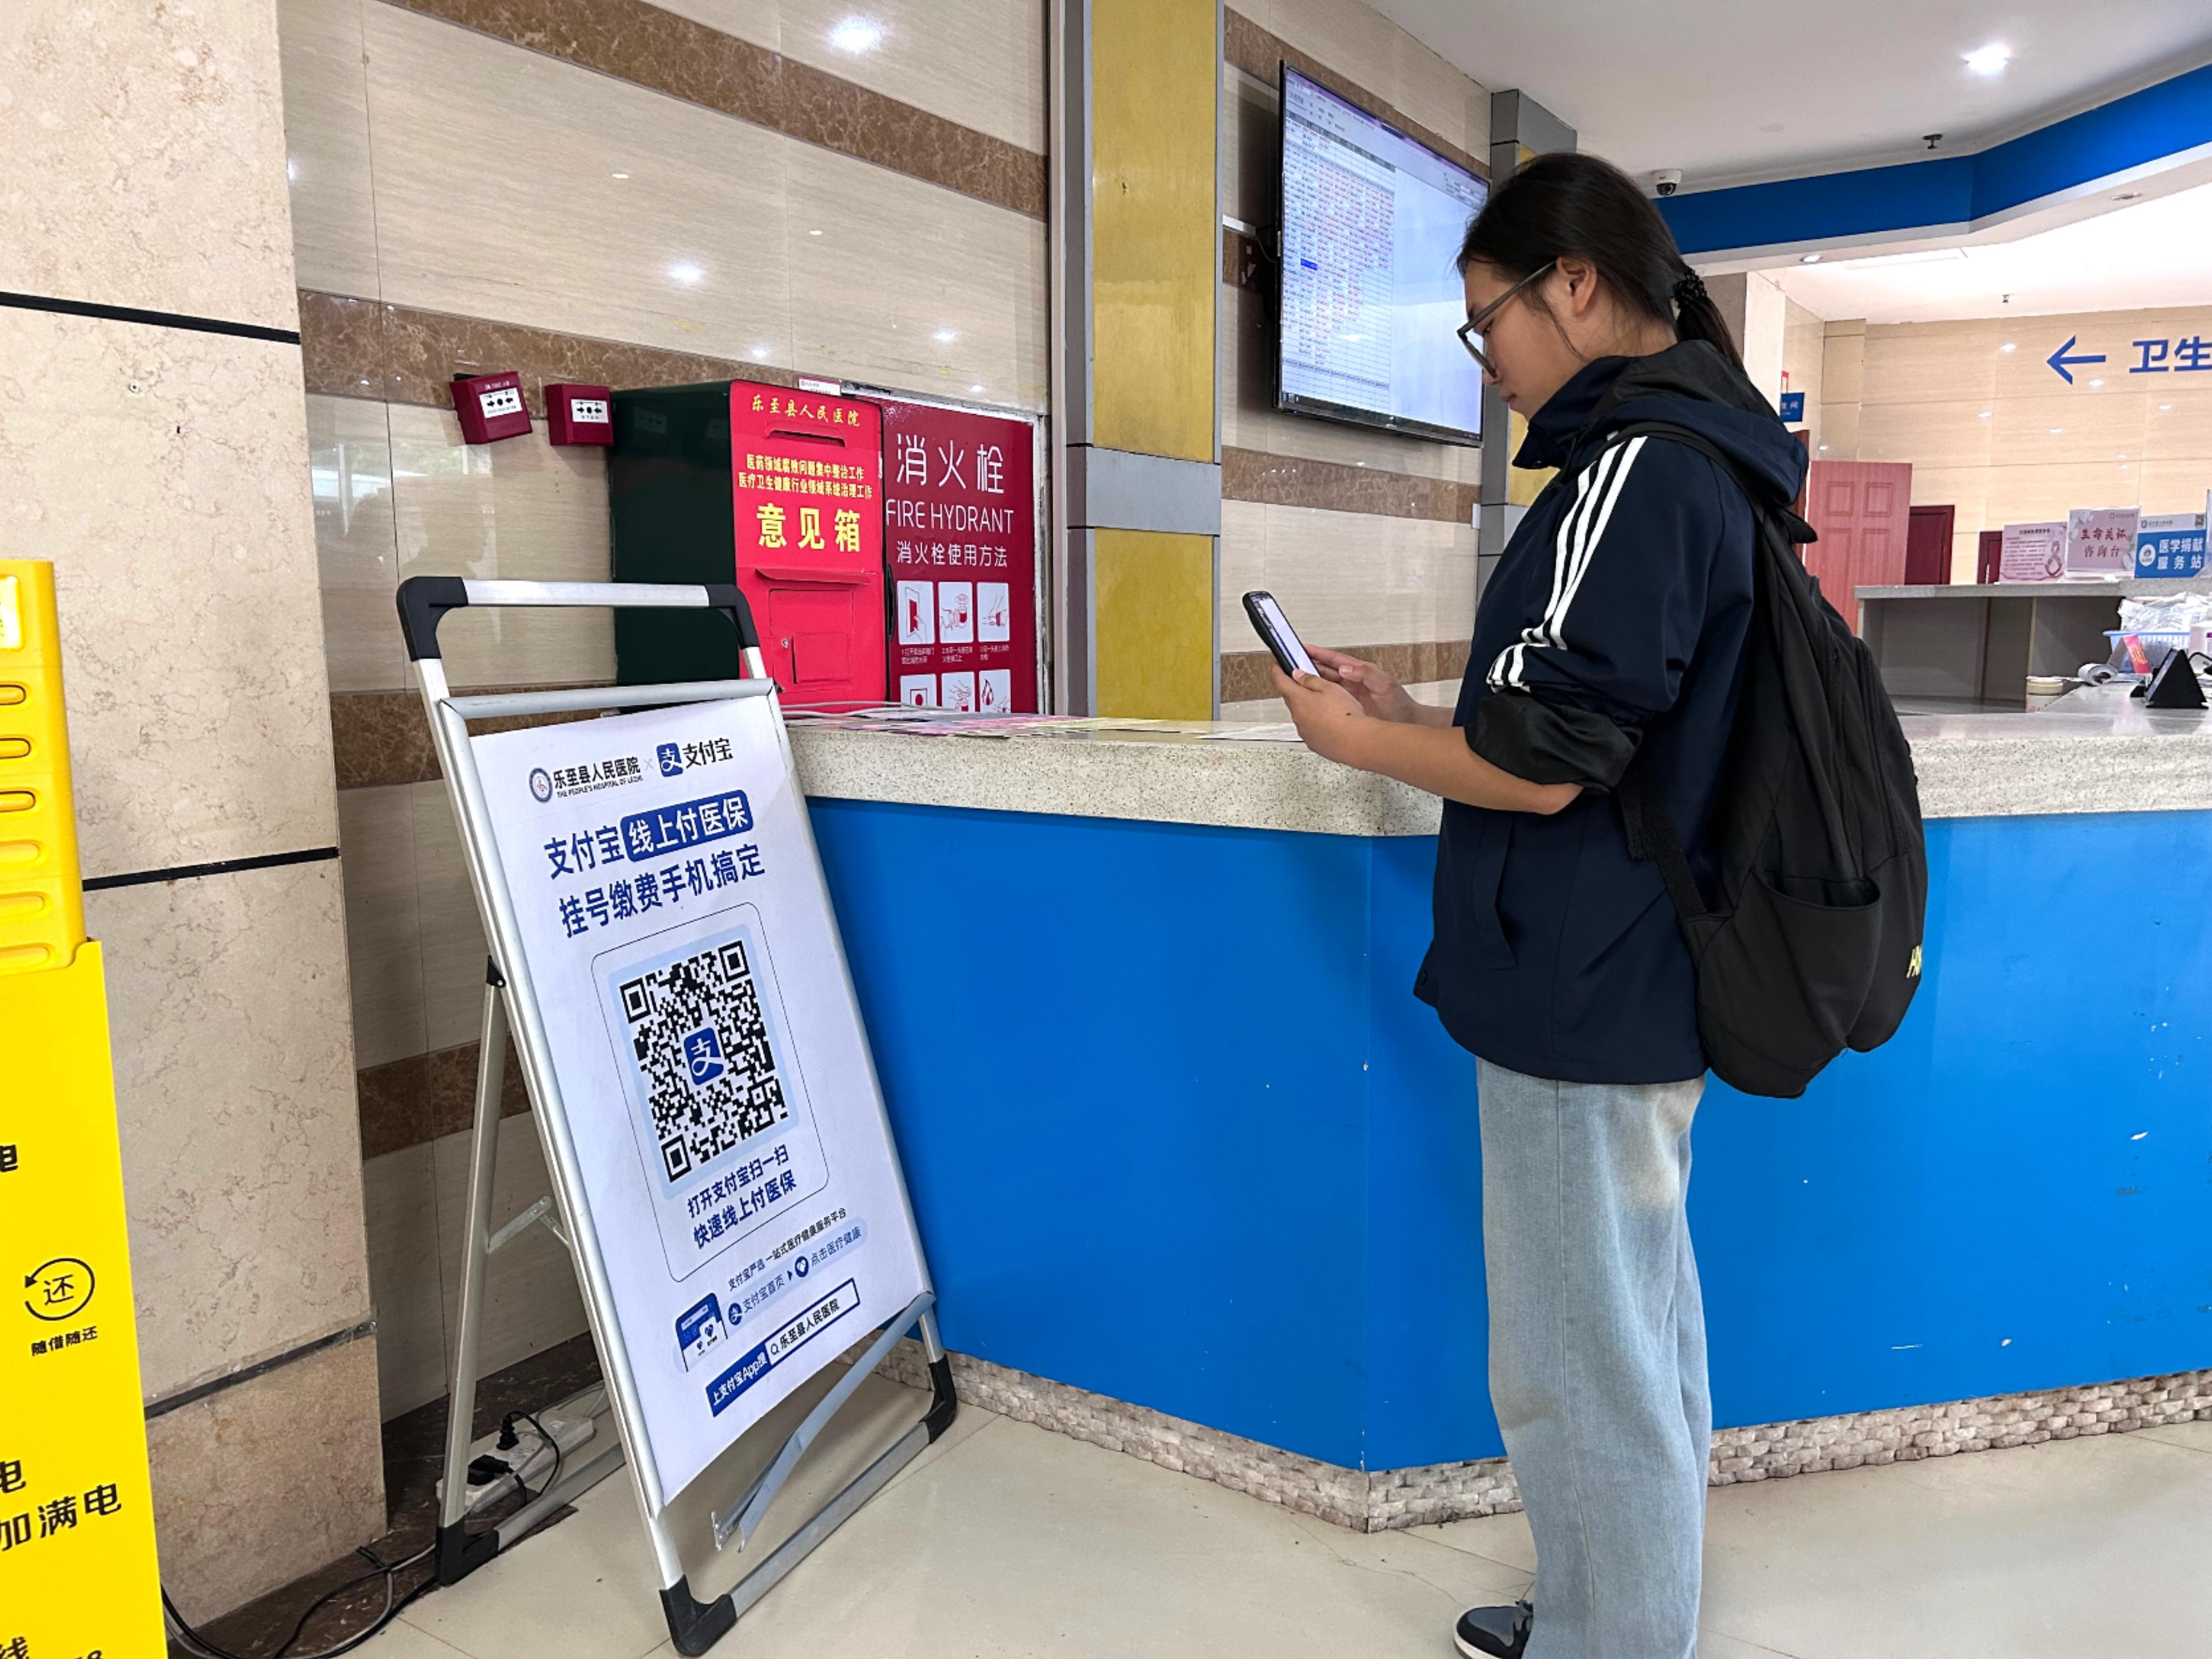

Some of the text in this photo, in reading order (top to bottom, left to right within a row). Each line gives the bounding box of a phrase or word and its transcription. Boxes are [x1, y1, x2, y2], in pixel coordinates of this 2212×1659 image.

[752, 394, 860, 427] 乐至县人民医院
[747, 454, 865, 481] 医药领域腐败问题集中整治工作
[896, 433, 1005, 494] 消火栓
[738, 472, 873, 500] 医疗卫生健康行业领域系统治理工作
[756, 503, 861, 552] 意见箱
[886, 499, 1014, 534] FIRE HYDRANT
[896, 540, 1007, 568] 消火栓使用方法
[2157, 555, 2203, 570] 服务站
[553, 757, 641, 789] 乐至县人民医院
[682, 737, 733, 769] 支付宝
[543, 795, 749, 879] 支付宝 线上付医保
[558, 843, 765, 939] 挂号缴费手机搞定
[687, 1144, 789, 1218] 打开支付宝扫一扫
[692, 1169, 797, 1250] 快速线上付医保
[765, 1207, 847, 1262] 一站式医疗健康服务平台
[43, 1274, 75, 1306] 还
[742, 1226, 862, 1313] 支付宝首页 点击医疗健康
[31, 1325, 99, 1357] 随借随还
[778, 1298, 839, 1350] 乐至县人民医院
[0, 1483, 122, 1552] 加满电
